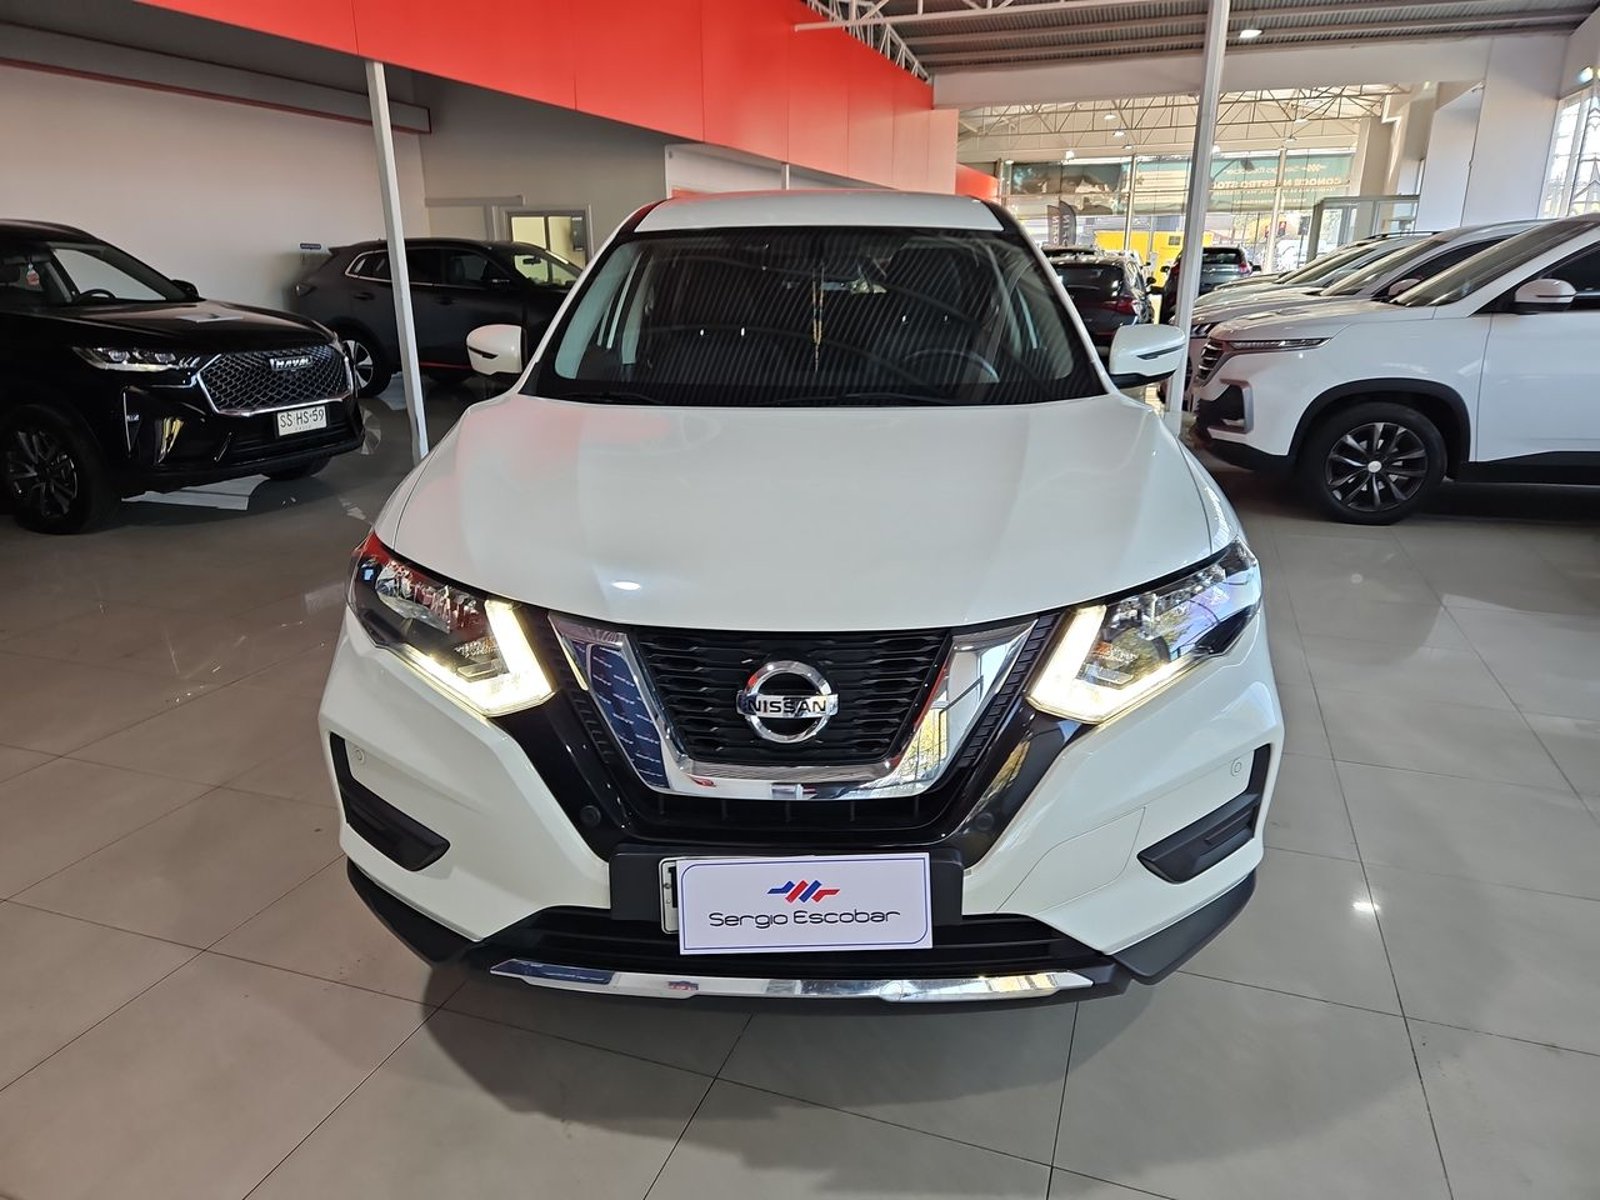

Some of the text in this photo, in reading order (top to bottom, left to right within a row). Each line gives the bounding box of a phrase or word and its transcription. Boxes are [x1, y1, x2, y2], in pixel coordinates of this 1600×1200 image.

[748, 699, 827, 714] NISSAN
[708, 908, 901, 929] Sergio Escobar
